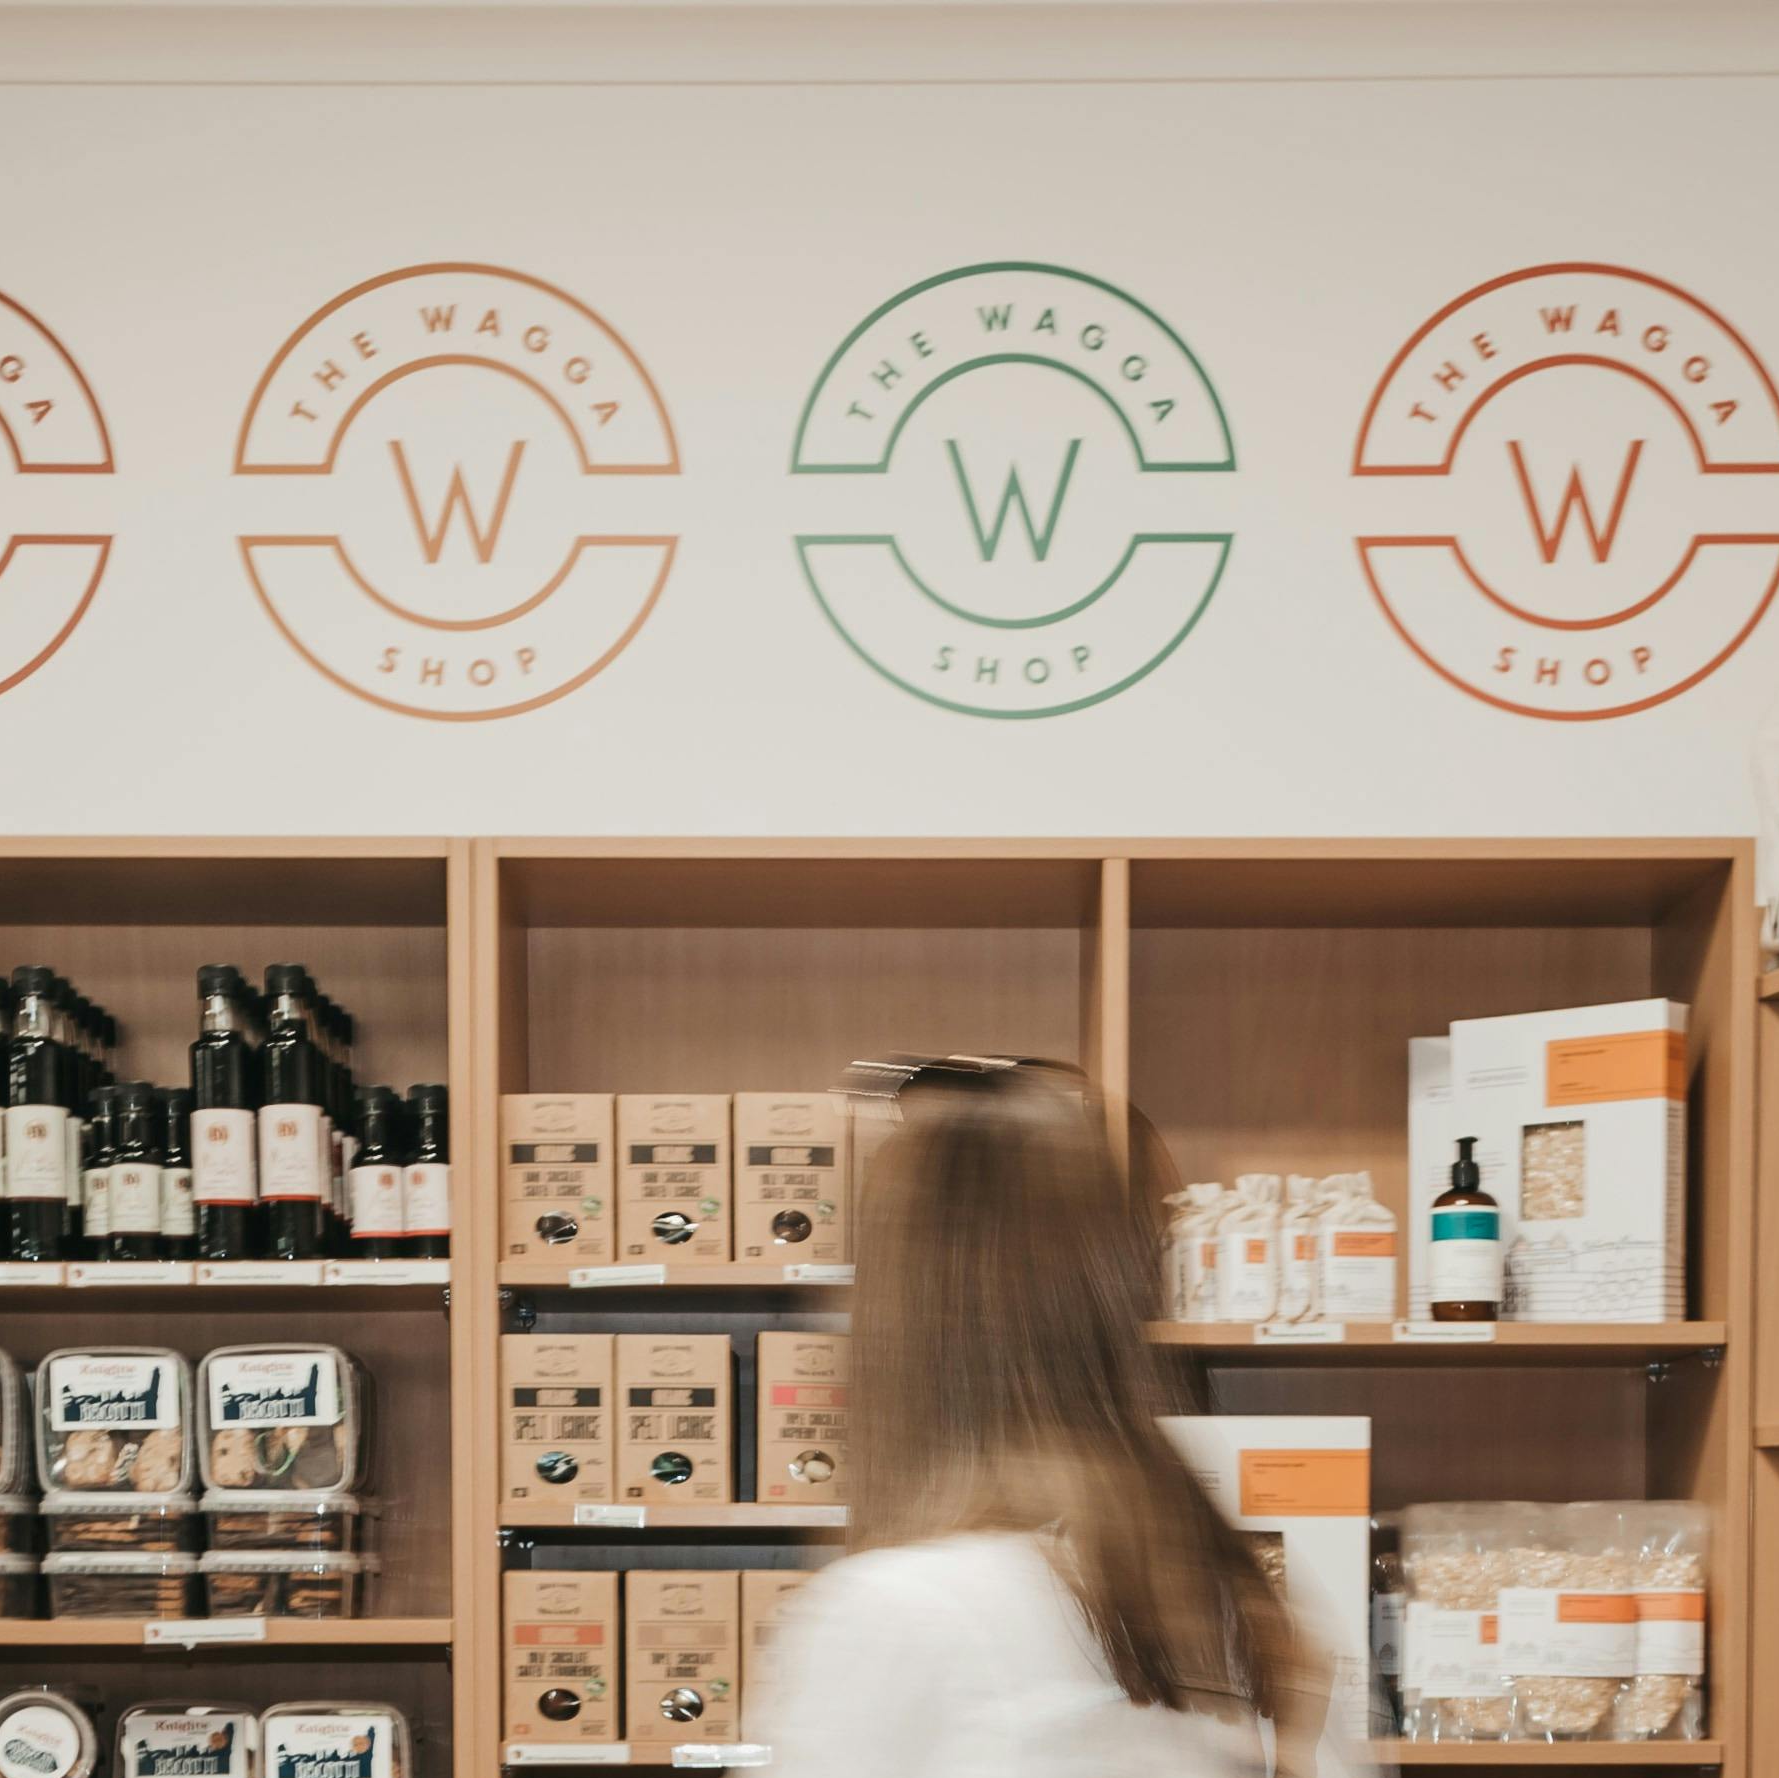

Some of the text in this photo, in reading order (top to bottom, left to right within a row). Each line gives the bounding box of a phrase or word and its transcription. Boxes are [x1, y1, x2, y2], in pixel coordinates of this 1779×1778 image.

[286, 300, 624, 429] THE WAGGA
[843, 300, 1180, 427] THE WAGGA
[1404, 301, 1743, 429] THE WAGGA
[386, 438, 528, 566] W
[943, 436, 1084, 564] W
[1504, 437, 1647, 567] W
[377, 645, 538, 689] SHOP
[934, 644, 1091, 687] SHOP
[1492, 644, 1654, 688] SHOP
